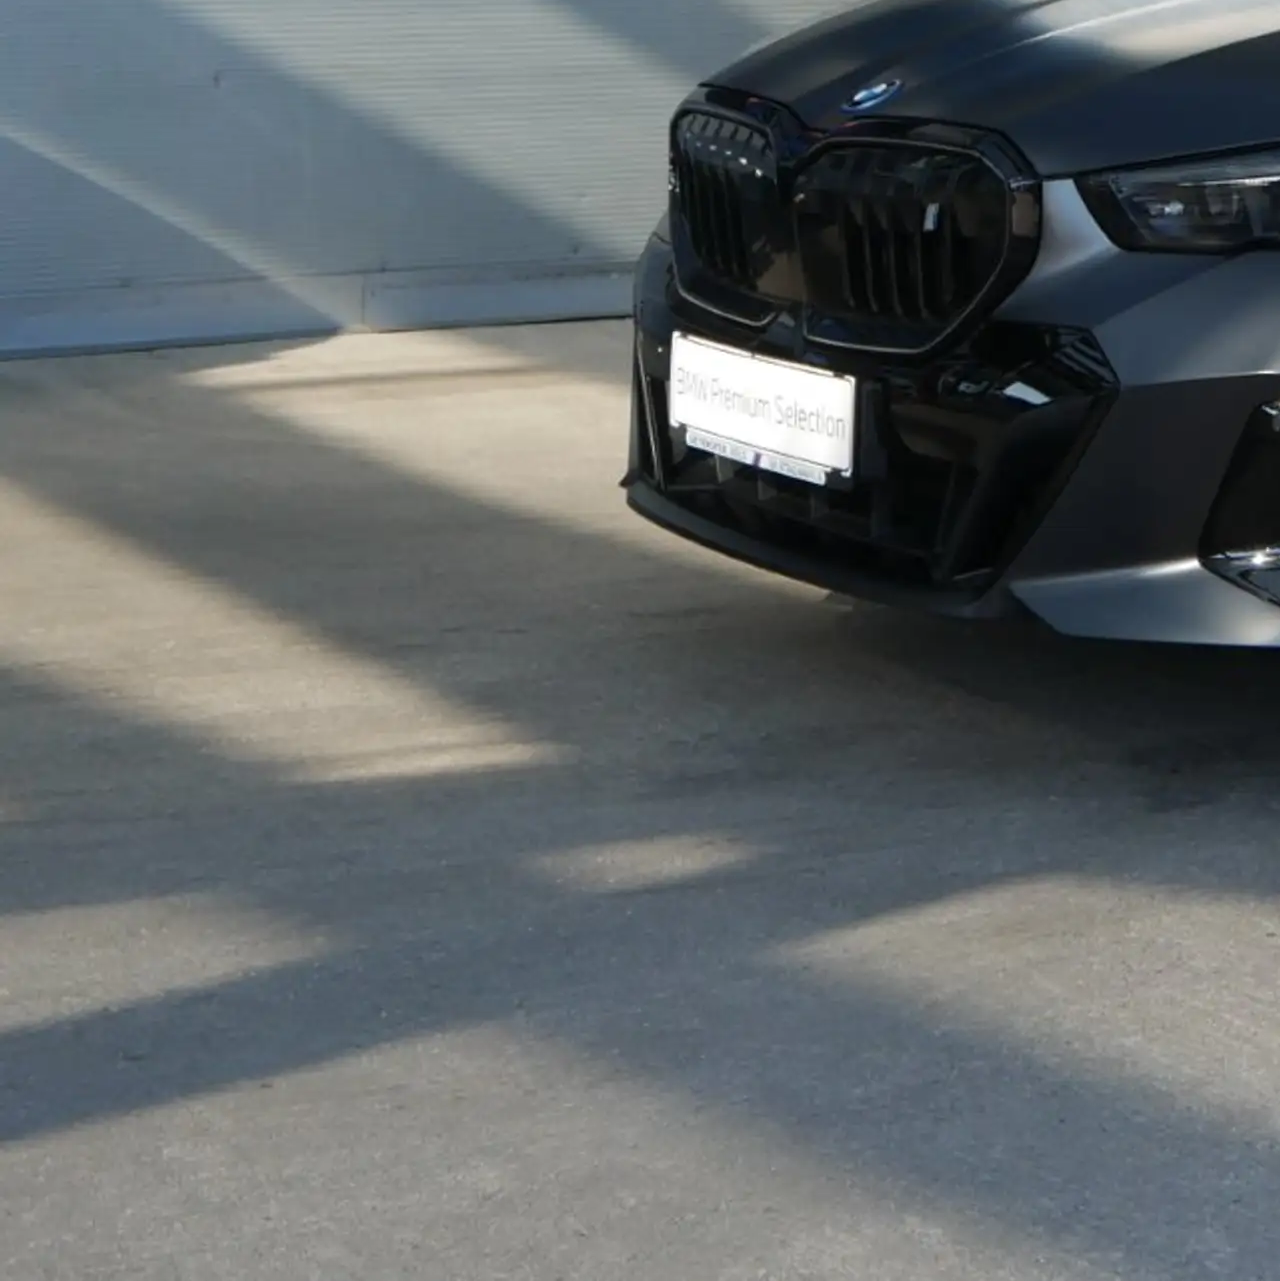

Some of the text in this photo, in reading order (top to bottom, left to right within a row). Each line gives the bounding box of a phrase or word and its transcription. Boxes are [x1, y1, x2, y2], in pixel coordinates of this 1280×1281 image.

[677, 366, 847, 440] BMW Premium Selection
